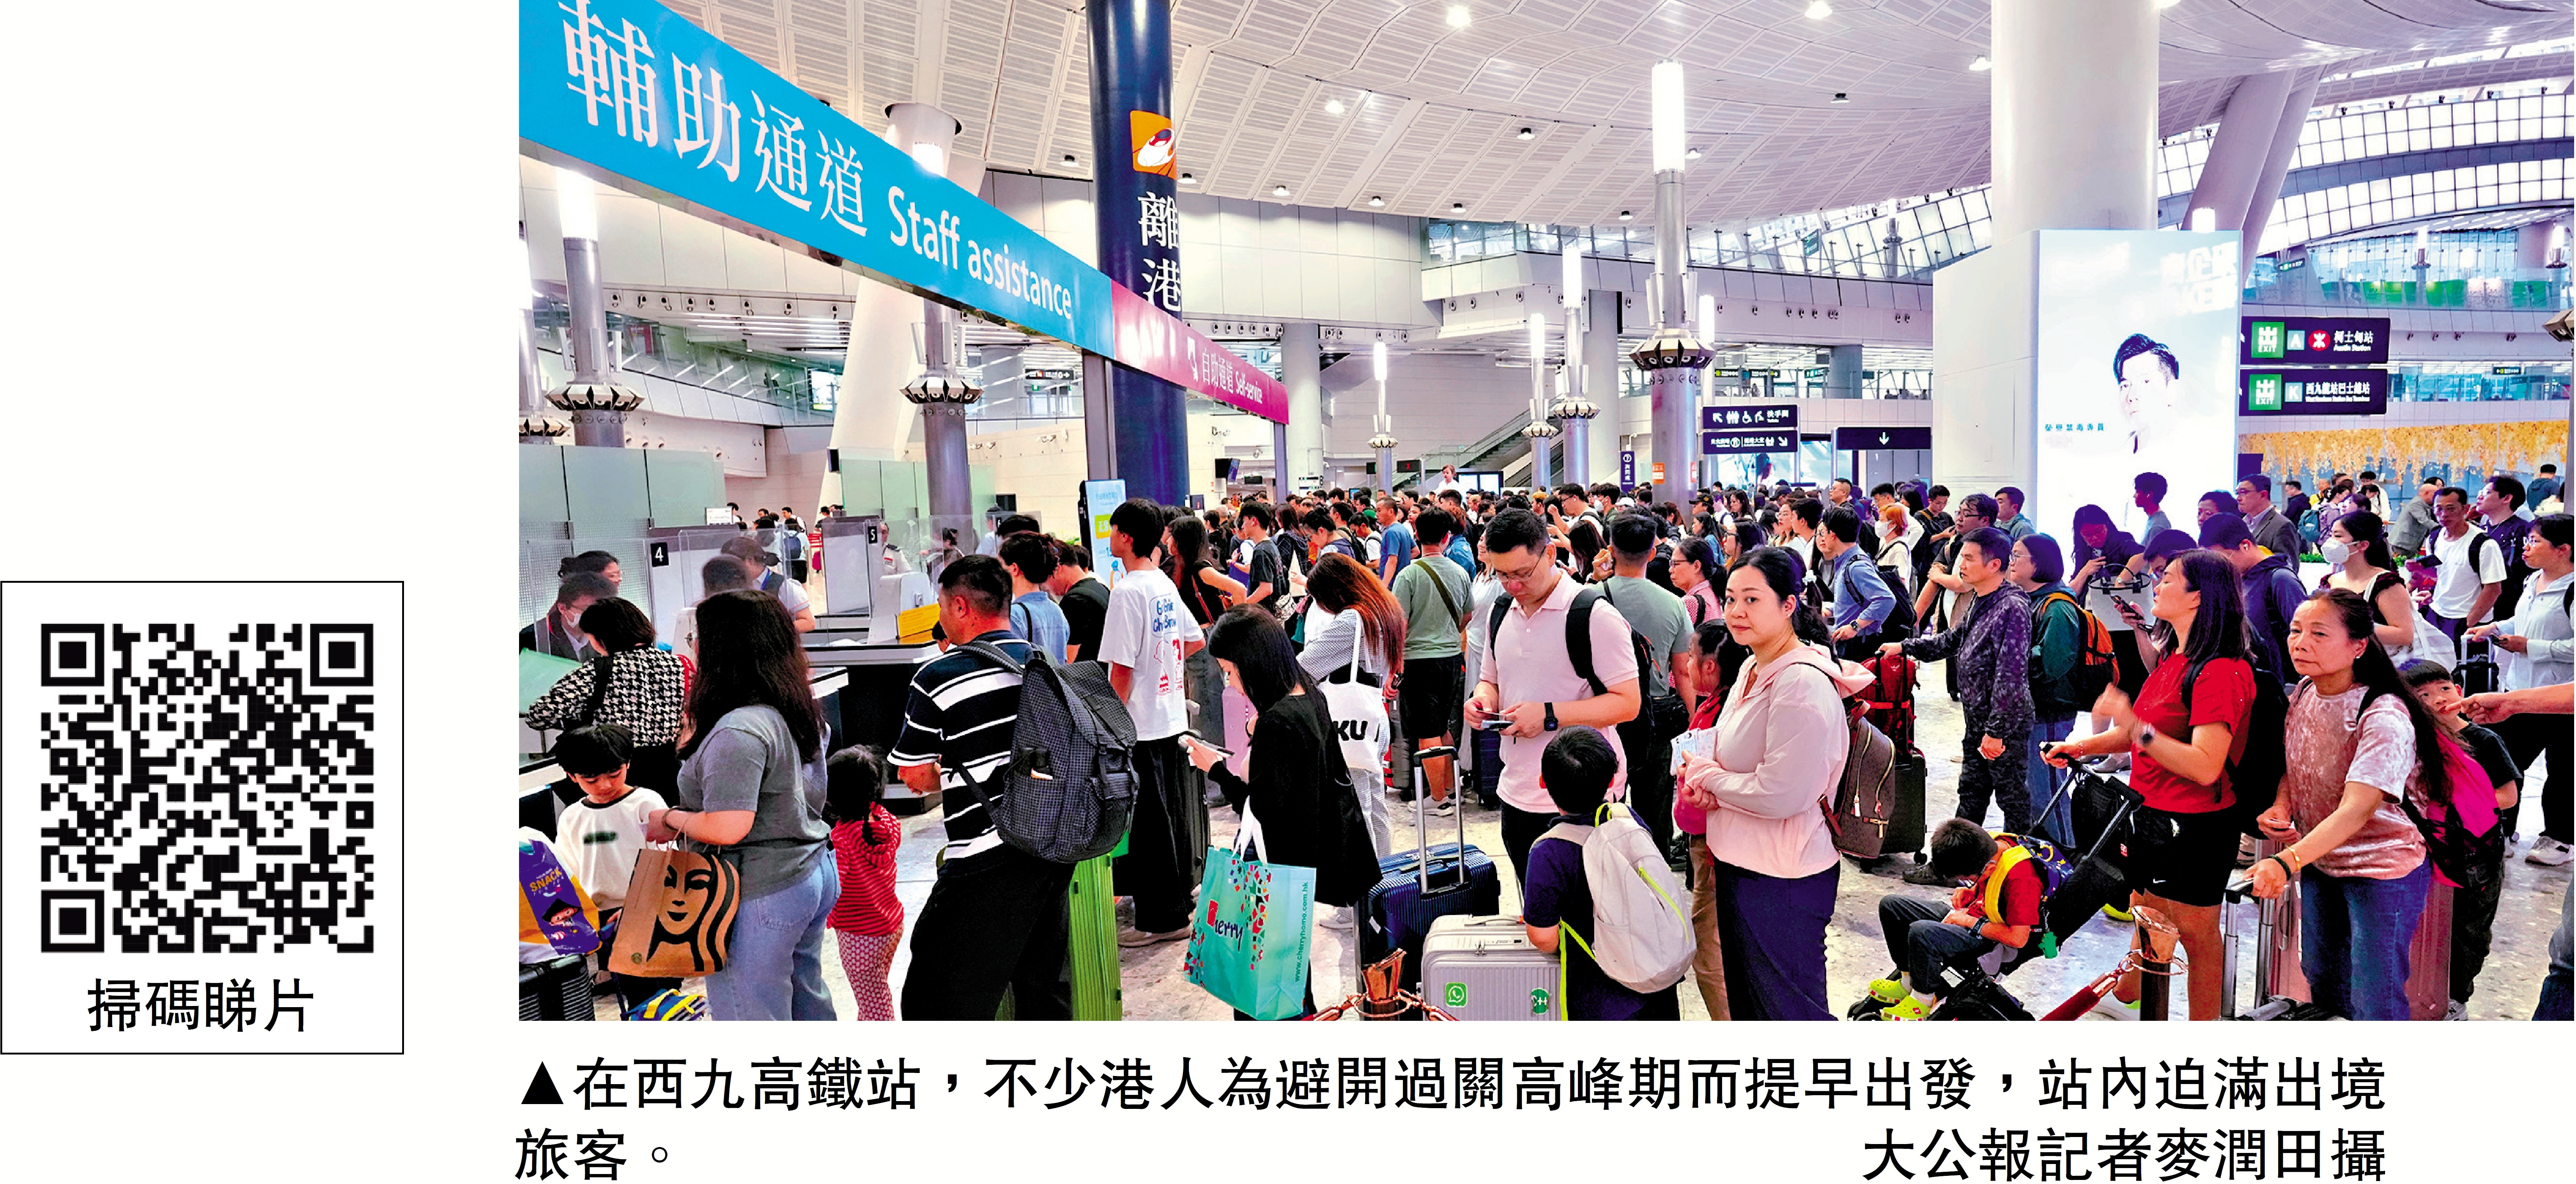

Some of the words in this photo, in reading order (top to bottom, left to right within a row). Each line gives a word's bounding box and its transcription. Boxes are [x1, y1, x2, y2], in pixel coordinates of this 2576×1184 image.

[558, 0, 867, 237] 輔助通道
[888, 185, 960, 269] Staff
[967, 242, 1072, 319] assistance
[1138, 191, 1181, 312] 離港
[2290, 333, 2301, 348] A
[1202, 347, 1233, 394] 自助通道
[1235, 371, 1263, 404] Self-service
[2289, 386, 2299, 400] K
[870, 529, 876, 541] 5
[654, 546, 664, 564] 4
[529, 867, 562, 892] SNACK
